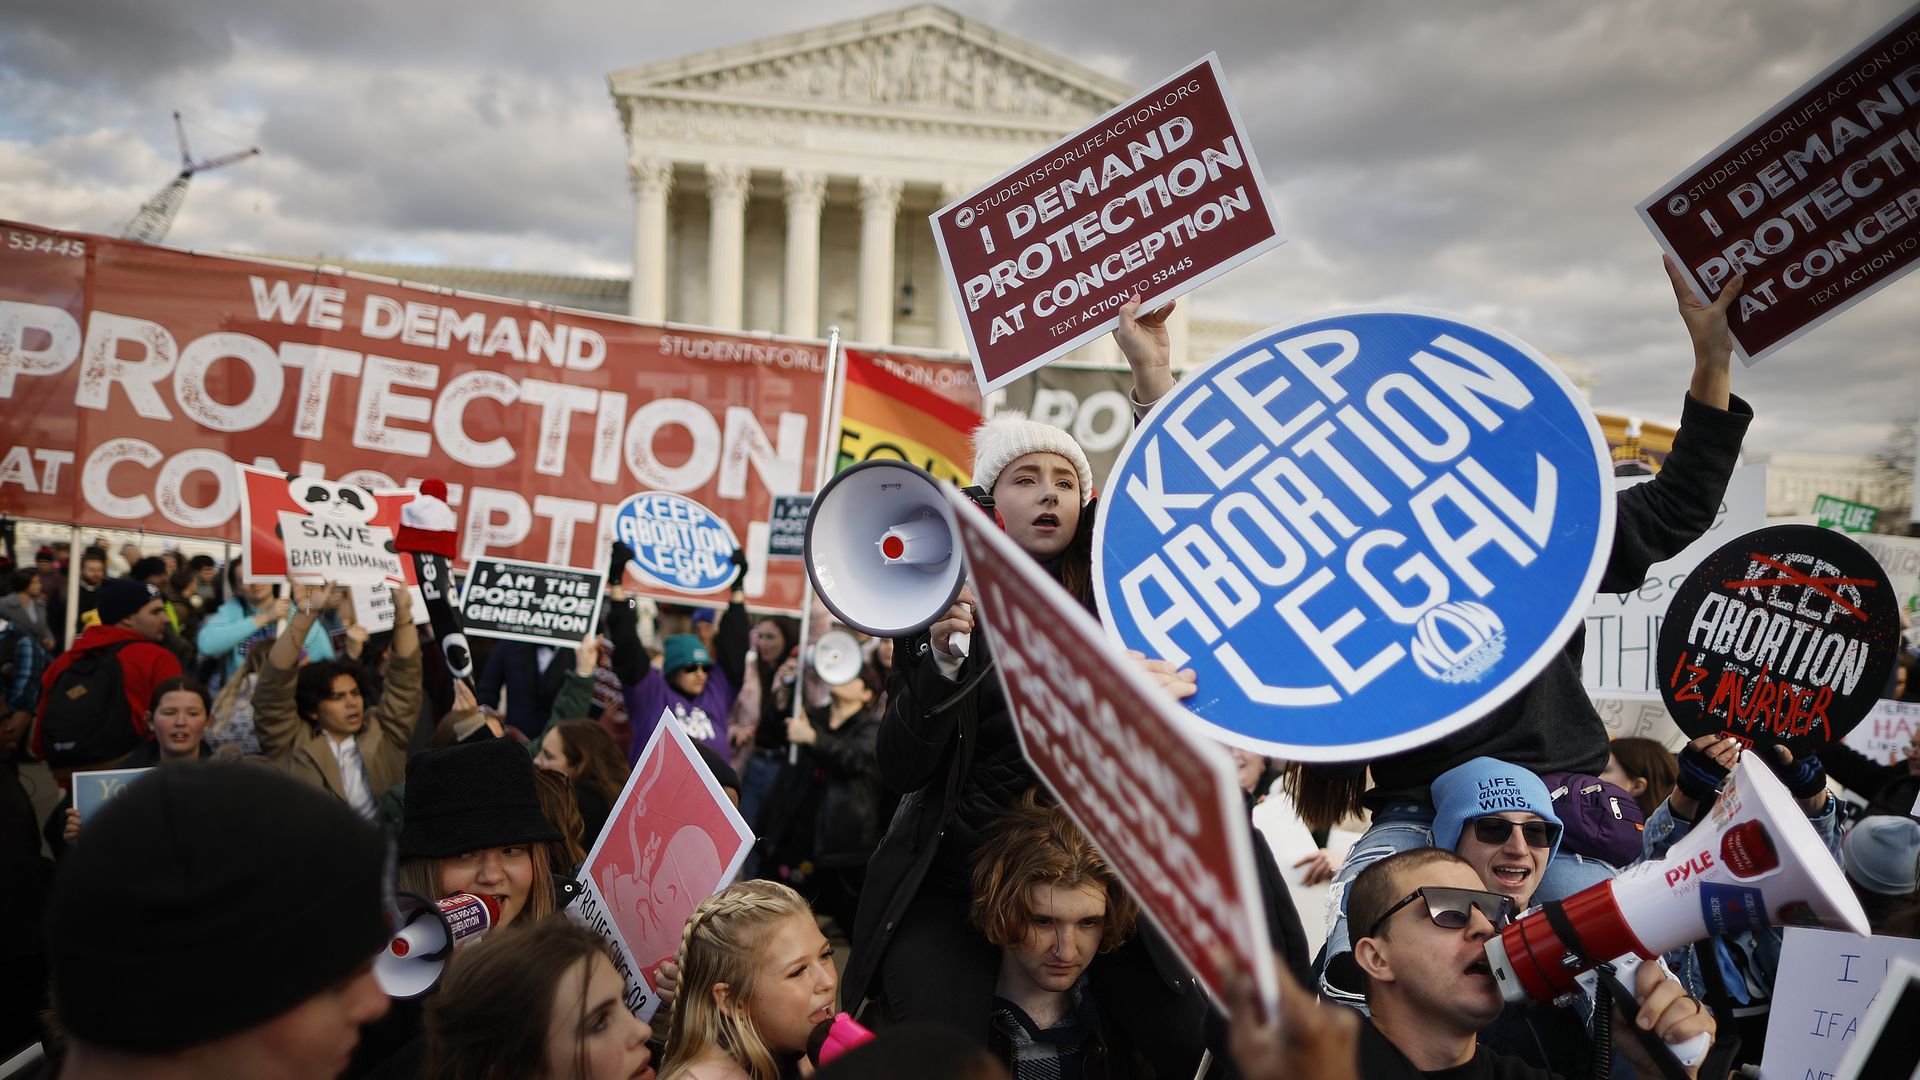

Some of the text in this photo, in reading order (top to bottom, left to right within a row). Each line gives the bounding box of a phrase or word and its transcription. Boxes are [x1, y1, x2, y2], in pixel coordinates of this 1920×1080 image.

[975, 79, 1201, 216] STUDENTSFORLIFEACTION.ORG
[980, 115, 1194, 255] I DEMAND
[1695, 120, 1920, 295] PROTECTI
[8, 231, 86, 257] 53445
[962, 135, 1244, 312] PROTECTION
[1699, 208, 1724, 238] I
[989, 185, 1252, 346] AT CONCEPTION
[1808, 236, 1918, 308] TEXT ACTION TO
[249, 275, 607, 372] WE DEMAND
[1049, 255, 1194, 338] TEXT ACTION TO 53445
[1738, 278, 1780, 323] AT
[0, 299, 808, 500] PROTECTION
[1126, 328, 1360, 536] KEEP
[0, 445, 75, 496] AT
[1119, 333, 1536, 669] ABORTION
[301, 519, 374, 547] SAVE
[619, 514, 735, 558] ABORTION
[634, 496, 706, 525] KEEP
[291, 549, 399, 574] BABY HUMANS
[478, 570, 489, 585] I
[497, 573, 536, 591] AM
[545, 577, 592, 598] THE
[635, 543, 728, 580] LEGAL
[1212, 450, 1559, 707] LEGAL
[1739, 552, 1862, 625] KEEP
[465, 603, 588, 634] GENERATION
[467, 584, 595, 617] POST-ROE
[1411, 600, 1505, 680] NOW
[1687, 590, 1870, 697] ABORTION
[1707, 663, 1834, 744] MURDER
[1478, 777, 1517, 791] LIFE
[1478, 787, 1521, 800] always
[1664, 850, 1715, 888] PYLE
[1837, 953, 1861, 984] I
